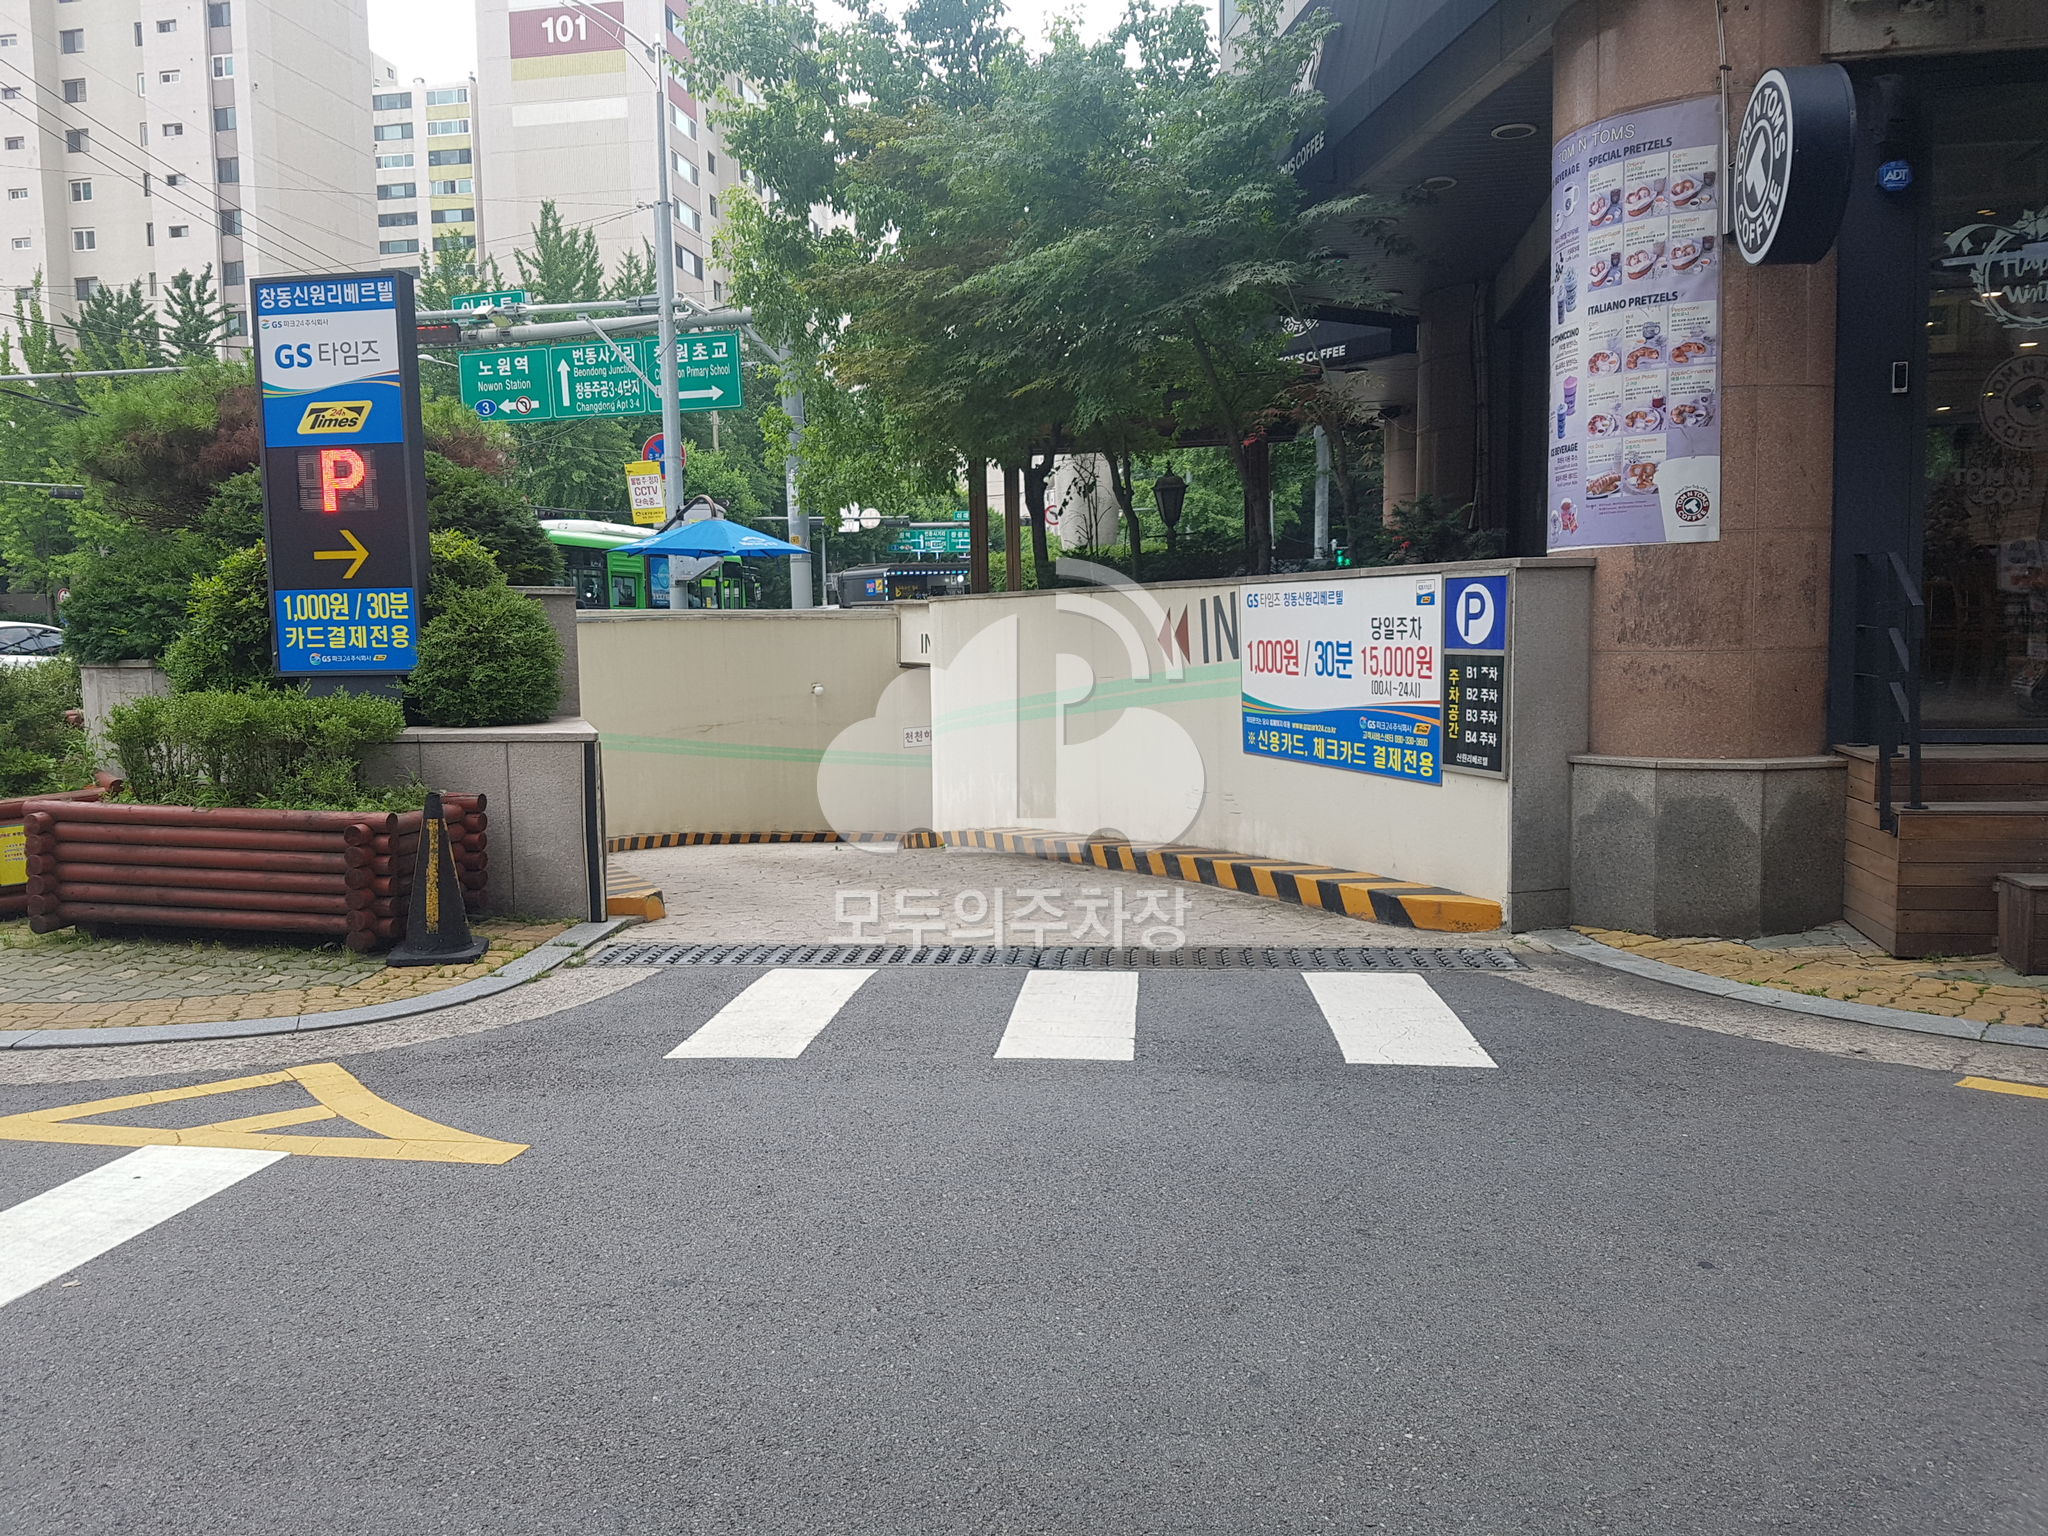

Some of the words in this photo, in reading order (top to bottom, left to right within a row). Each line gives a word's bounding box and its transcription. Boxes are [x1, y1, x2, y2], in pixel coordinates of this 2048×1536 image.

[541, 15, 587, 43] 101
[1578, 136, 1587, 151] N
[1592, 124, 1635, 146] TOMS
[1736, 116, 1752, 191] TOM
[1753, 93, 1762, 122] N
[1763, 87, 1786, 160] TOMS
[1588, 150, 1622, 168] SPECIAL
[1623, 137, 1673, 157] PRETZELS
[1884, 169, 1908, 181] ADT
[1738, 179, 1781, 248] COFFEE
[1588, 299, 1626, 316] ITALIANO
[1629, 291, 1678, 307] PRETZELS
[275, 343, 313, 369] GS
[318, 340, 381, 366] 타임즈
[478, 356, 529, 376] 노원역
[572, 344, 635, 365] 번동사거리
[574, 366, 607, 377] Beondong
[687, 367, 708, 379] Primary
[711, 364, 730, 376] School
[478, 381, 502, 391] Nowon
[506, 379, 531, 390] Station
[482, 402, 490, 414] 3
[576, 401, 615, 412] Changdong
[617, 400, 628, 411] Apt
[308, 407, 360, 430] Times
[321, 449, 365, 512] P
[634, 486, 658, 496] CCTV
[284, 593, 349, 621] 1,000원
[367, 592, 409, 619] 30분
[1247, 593, 1259, 608] GS
[1260, 592, 1280, 608] 타임즈
[1464, 591, 1486, 636] P
[285, 625, 410, 649] 카드결제전용
[1200, 591, 1240, 664] IN
[1371, 616, 1422, 640] 당일주차
[921, 633, 931, 653] IN
[1247, 639, 1299, 676] 1,000원
[1315, 640, 1353, 679] 30분
[1361, 646, 1433, 680] 15,000원
[1466, 667, 1477, 679] B1
[1448, 668, 1460, 739] 주차공간
[1466, 688, 1478, 701] B2
[1480, 689, 1498, 703] 주차
[1466, 709, 1477, 722] B3
[1480, 710, 1497, 725] 주차
[1465, 730, 1477, 744] B4
[1479, 731, 1497, 747] 주차
[1258, 729, 1308, 757] 신용카드,
[1314, 737, 1366, 765] 체크카드
[1373, 745, 1434, 777] 결제전용
